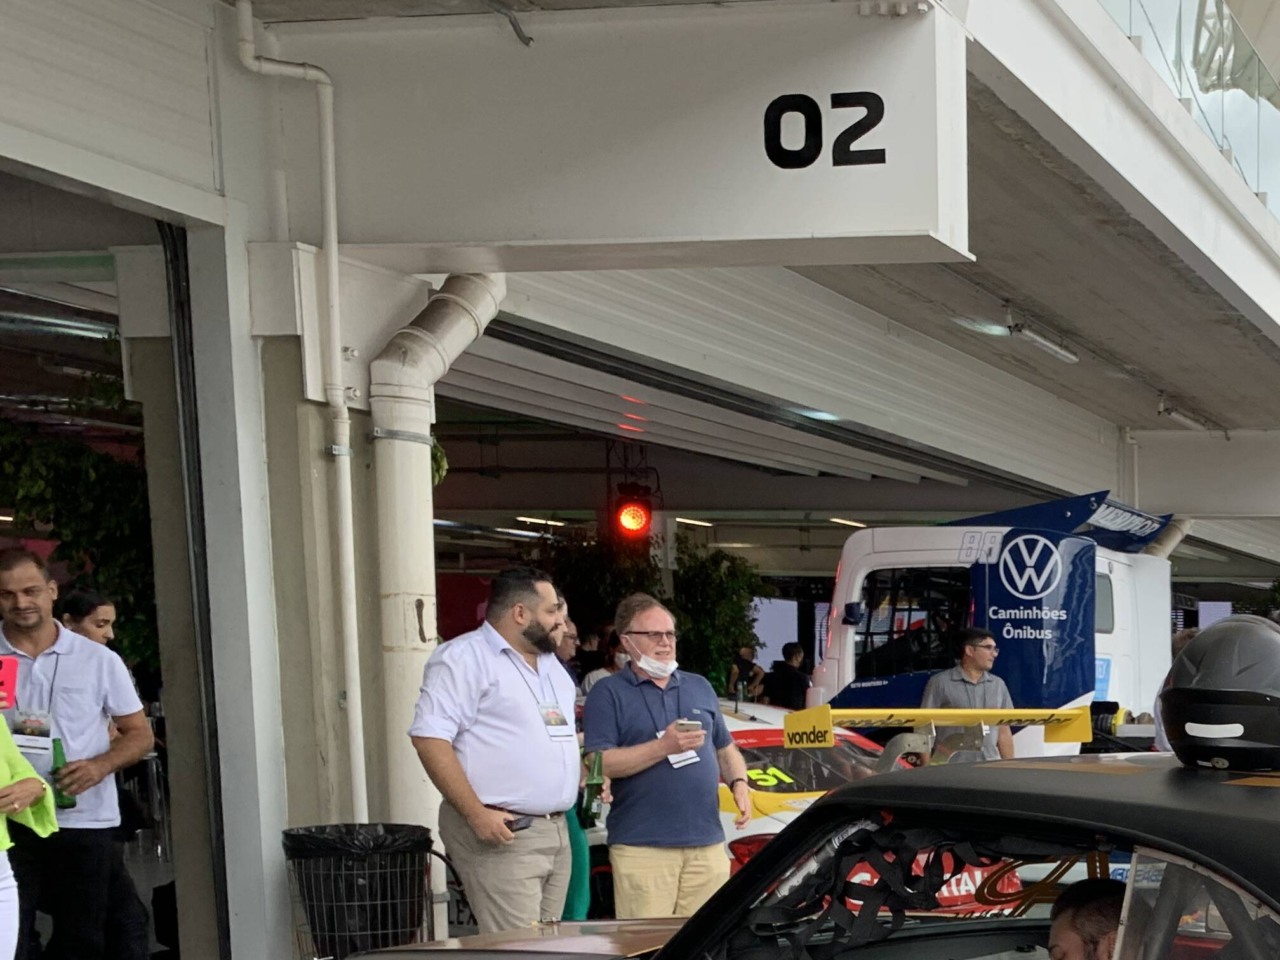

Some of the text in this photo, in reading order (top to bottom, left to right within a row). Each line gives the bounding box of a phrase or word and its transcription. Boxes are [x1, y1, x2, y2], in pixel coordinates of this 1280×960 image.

[763, 91, 887, 169] 02
[958, 531, 1003, 564] 88
[988, 605, 1067, 621] Caminhões
[1002, 623, 1053, 640] Ônibus
[787, 726, 829, 746] vonder
[747, 767, 795, 787] 51
